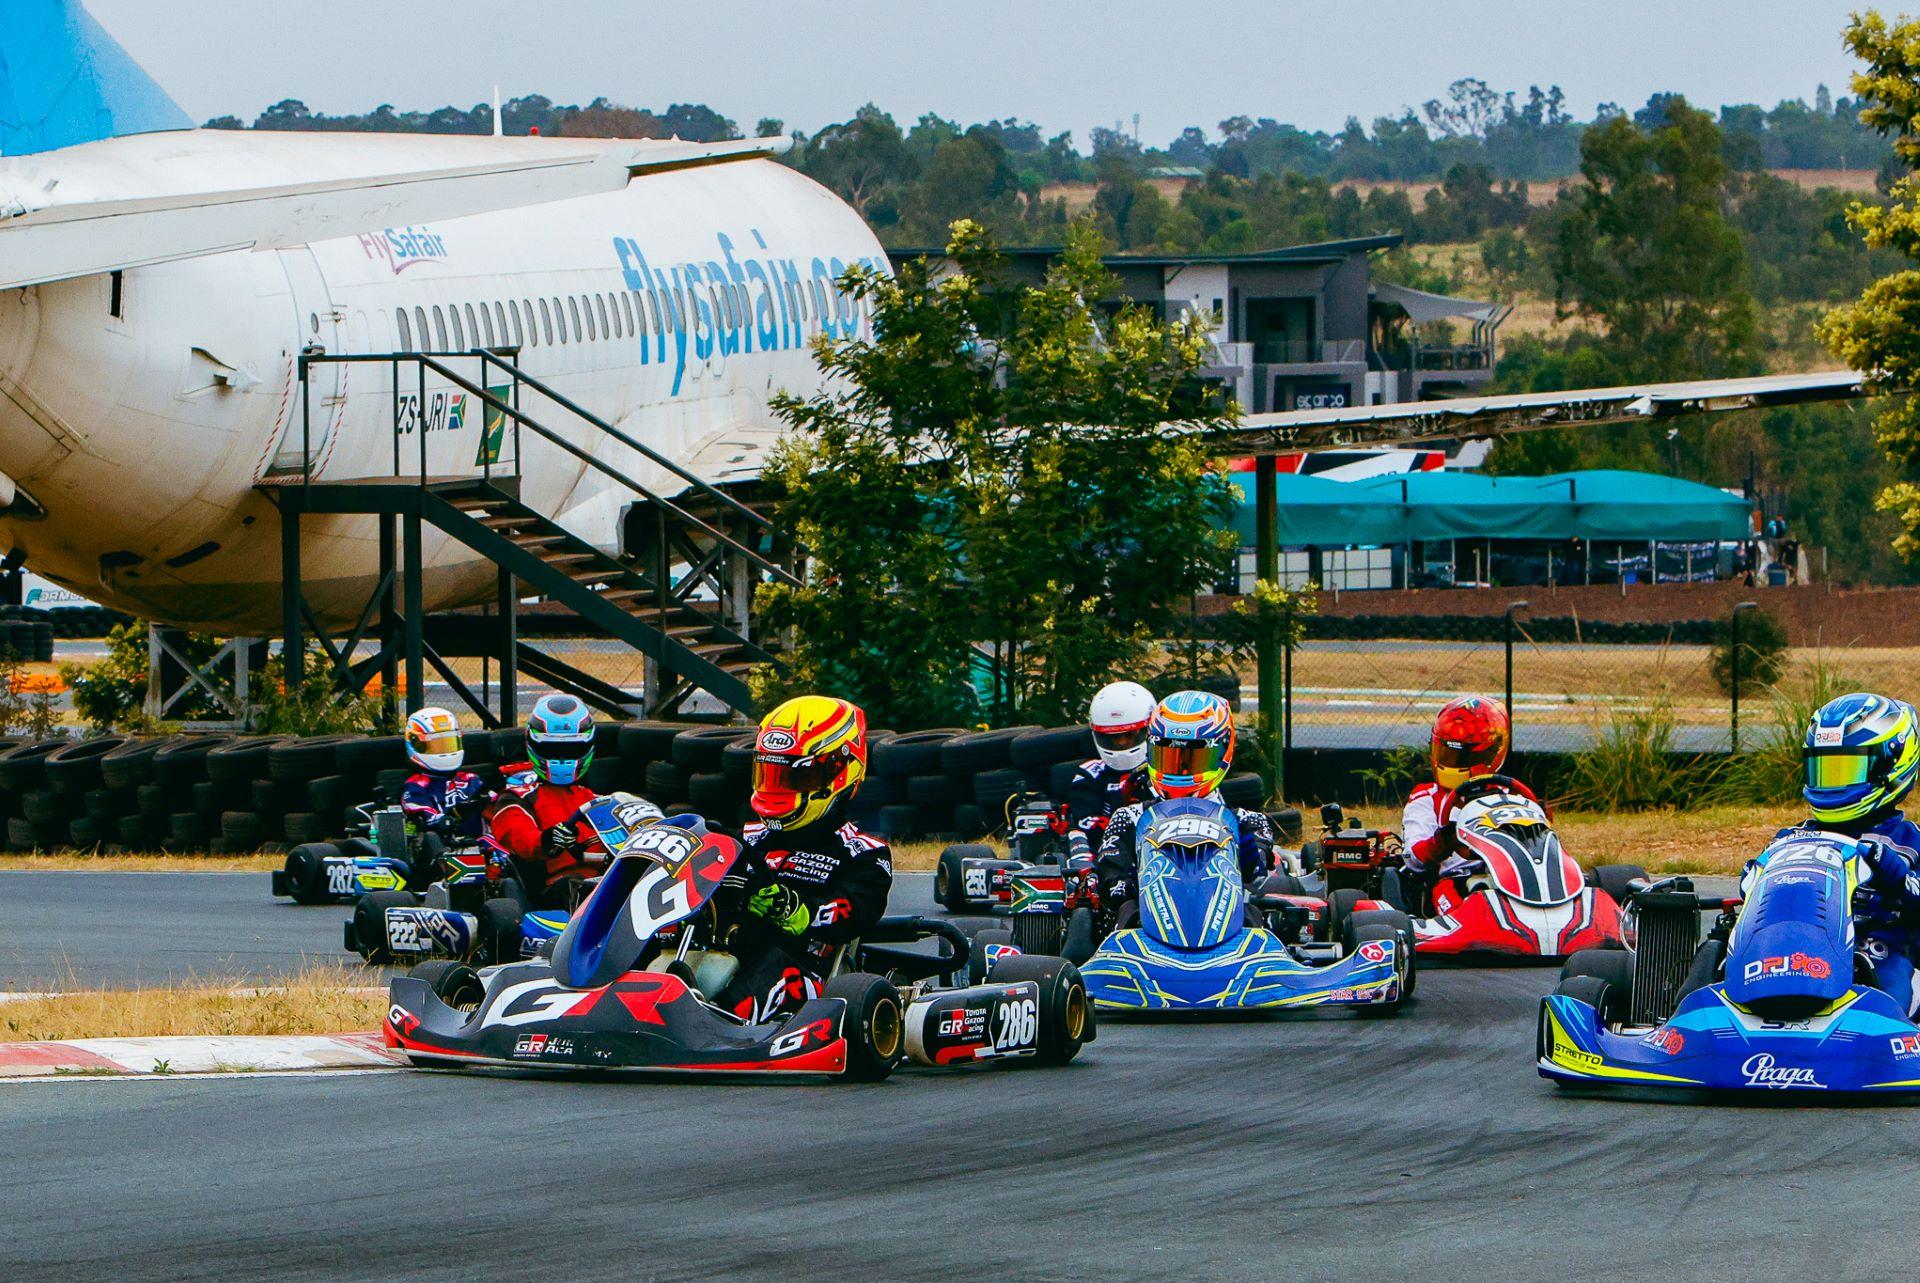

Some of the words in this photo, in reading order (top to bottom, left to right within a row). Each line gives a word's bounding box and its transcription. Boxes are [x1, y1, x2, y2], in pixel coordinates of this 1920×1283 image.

[356, 226, 448, 274] FlySafair
[762, 734, 789, 746] Arai
[1158, 818, 1221, 843] 296
[787, 856, 834, 871] GAZOO
[794, 850, 841, 866] TOYOTA
[1768, 843, 1844, 869] 226
[326, 865, 355, 893] 282
[811, 897, 852, 927] GR
[389, 921, 422, 950] 222
[1744, 956, 1789, 980] DPJ
[1744, 970, 1811, 986] ENGINEERING
[481, 970, 688, 1030] GR
[760, 966, 804, 1021] GR
[389, 1004, 421, 1037] GR
[965, 1008, 987, 1017] TOYOTA
[965, 1017, 985, 1025] GAZOO
[996, 999, 1036, 1050] 286
[769, 1018, 832, 1057] GR
[939, 1019, 963, 1034] GR
[515, 1041, 545, 1054] GR
[1554, 1042, 1602, 1065] STRETTO
[1741, 1052, 1828, 1090] Praga
